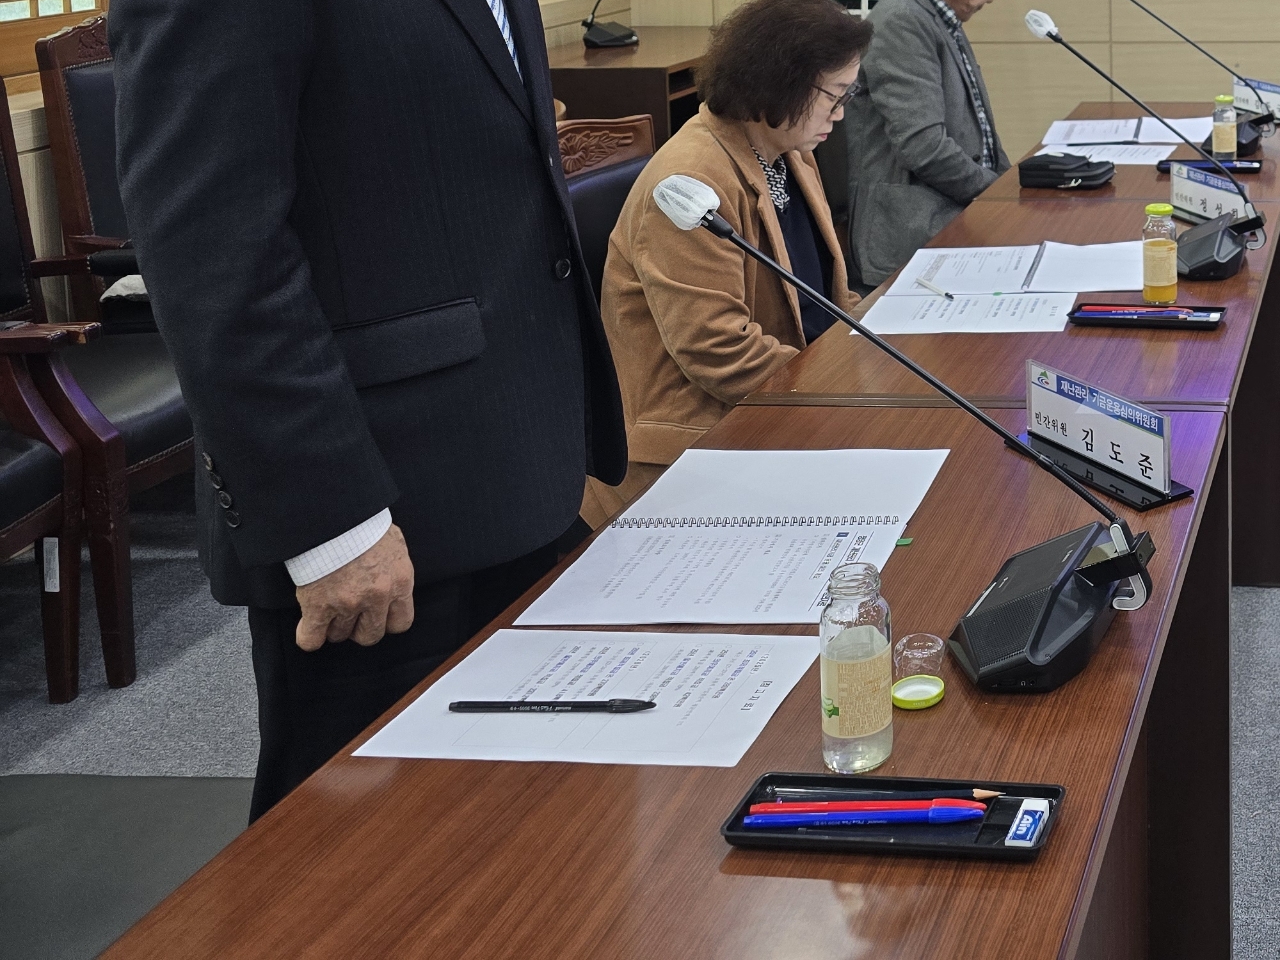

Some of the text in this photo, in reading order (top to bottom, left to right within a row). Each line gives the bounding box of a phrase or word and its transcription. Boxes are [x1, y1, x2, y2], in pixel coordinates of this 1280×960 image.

[1060, 379, 1158, 432] 재난관리 기금운용심의위원회
[1034, 411, 1153, 480] 민간위원 김 도 준
[1016, 814, 1034, 835] Ain
